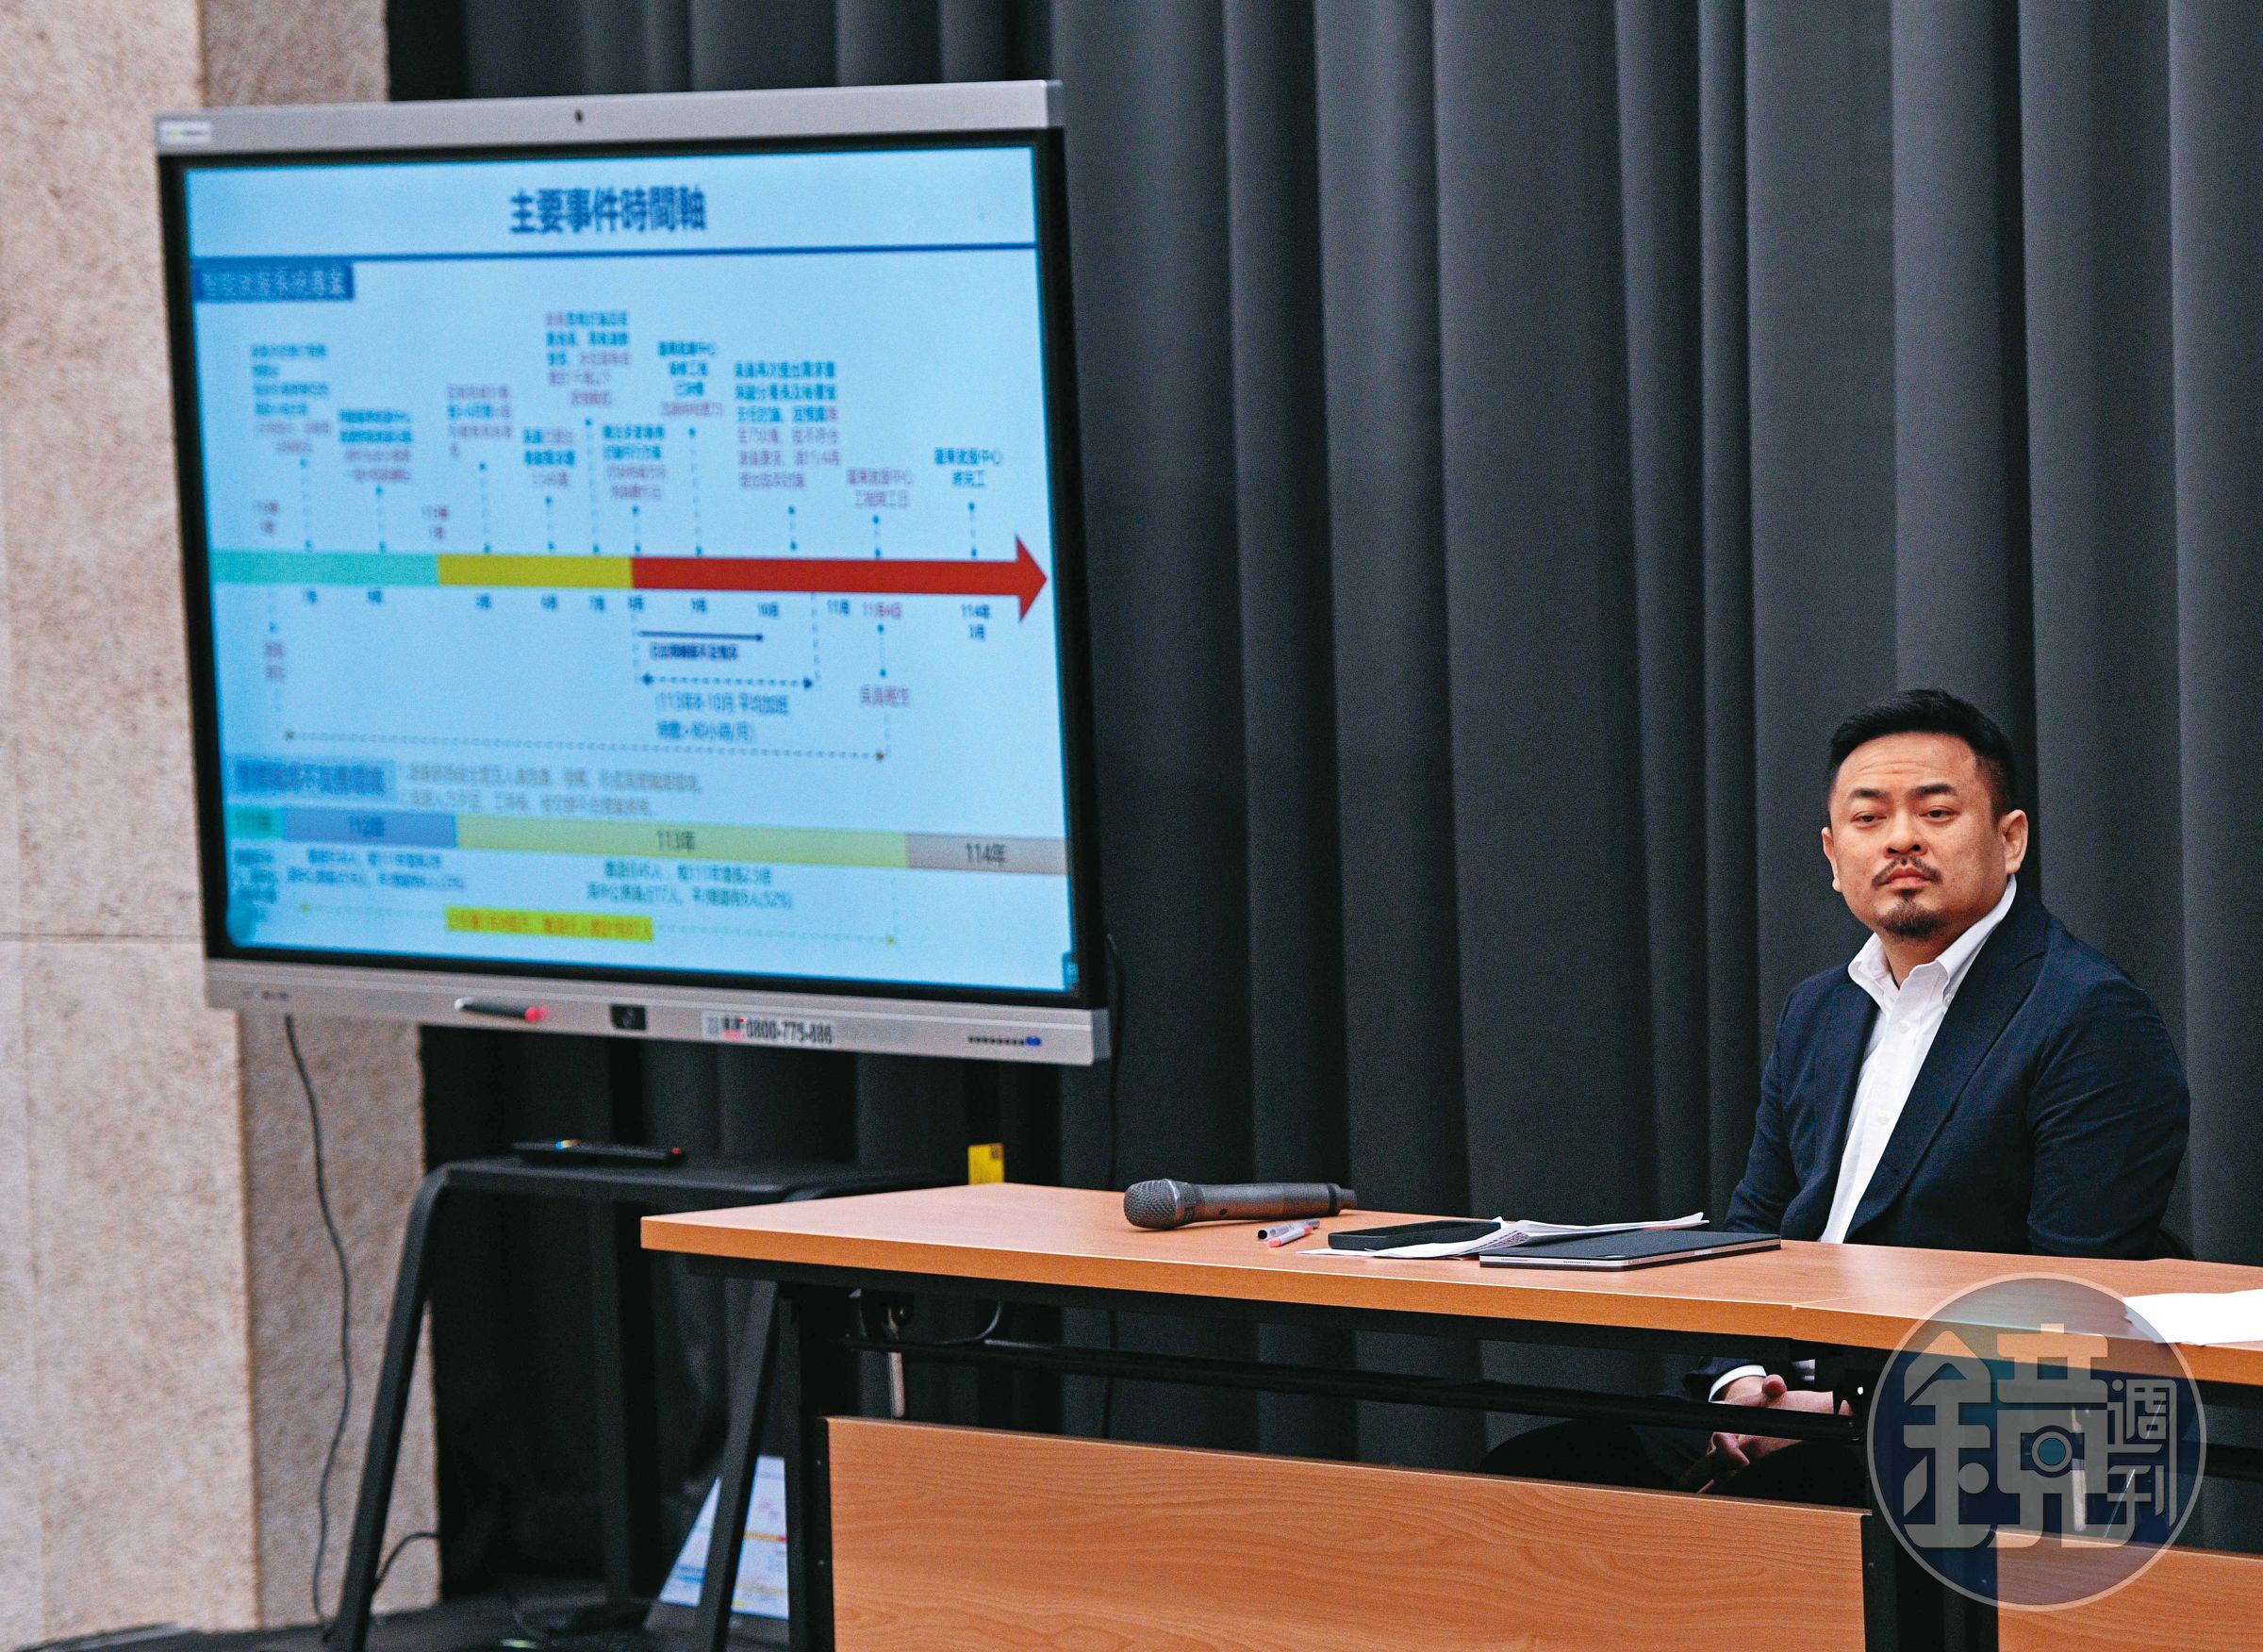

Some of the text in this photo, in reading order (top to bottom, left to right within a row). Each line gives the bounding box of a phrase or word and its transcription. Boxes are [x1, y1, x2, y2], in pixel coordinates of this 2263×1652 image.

[509, 186, 705, 233] 主要事件時間軸
[656, 830, 695, 851] 113年
[966, 843, 1006, 865] 114年
